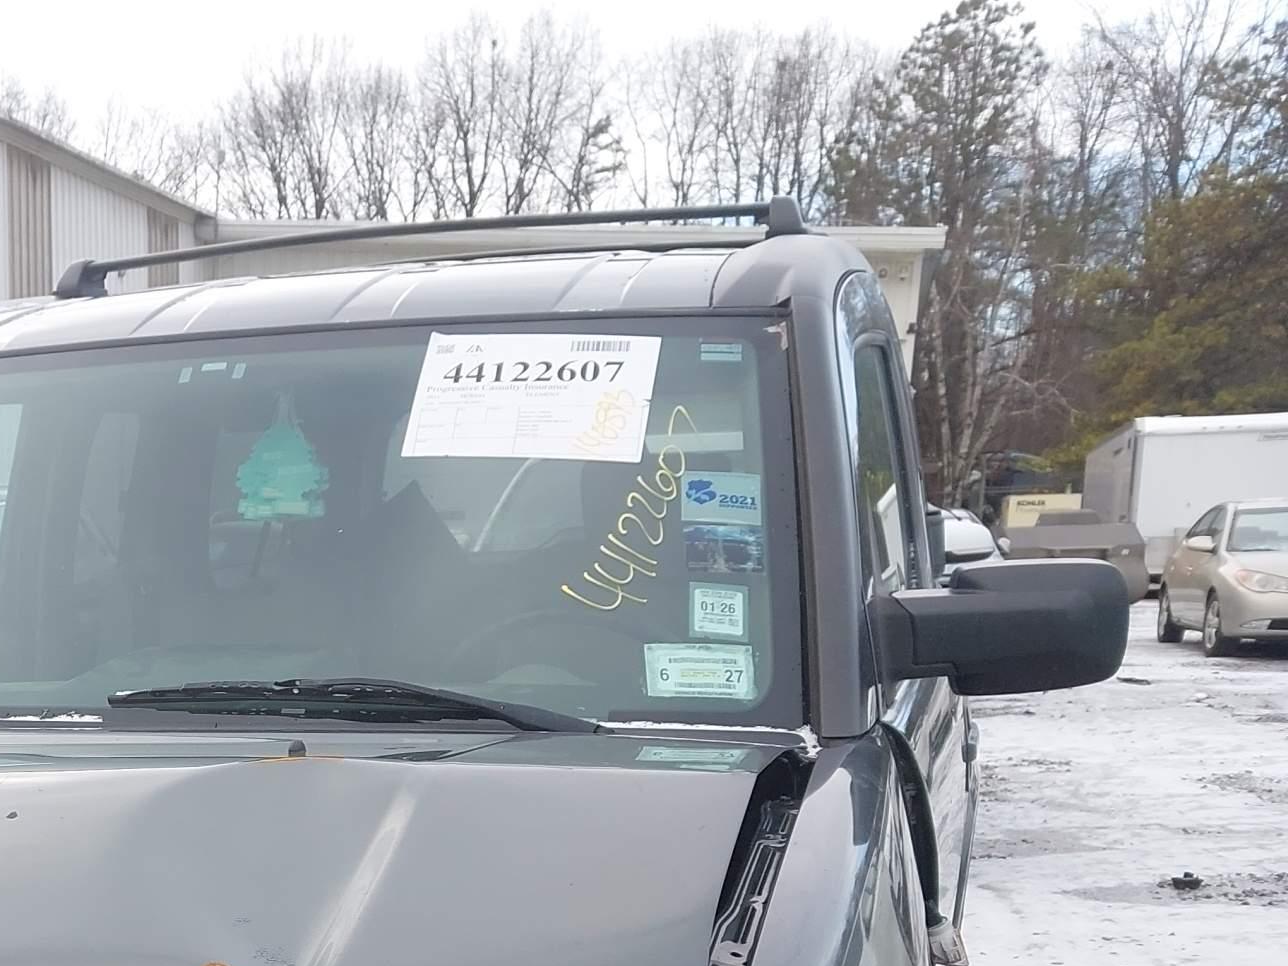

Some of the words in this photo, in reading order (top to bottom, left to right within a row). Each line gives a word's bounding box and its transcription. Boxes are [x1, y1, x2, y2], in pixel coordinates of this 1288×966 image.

[442, 359, 625, 384] 44122607
[561, 405, 698, 610] 44122607
[719, 494, 757, 506] 2021
[700, 600, 715, 612] 01
[720, 602, 736, 614] 26
[659, 668, 670, 681] 6
[724, 669, 744, 683] 27
